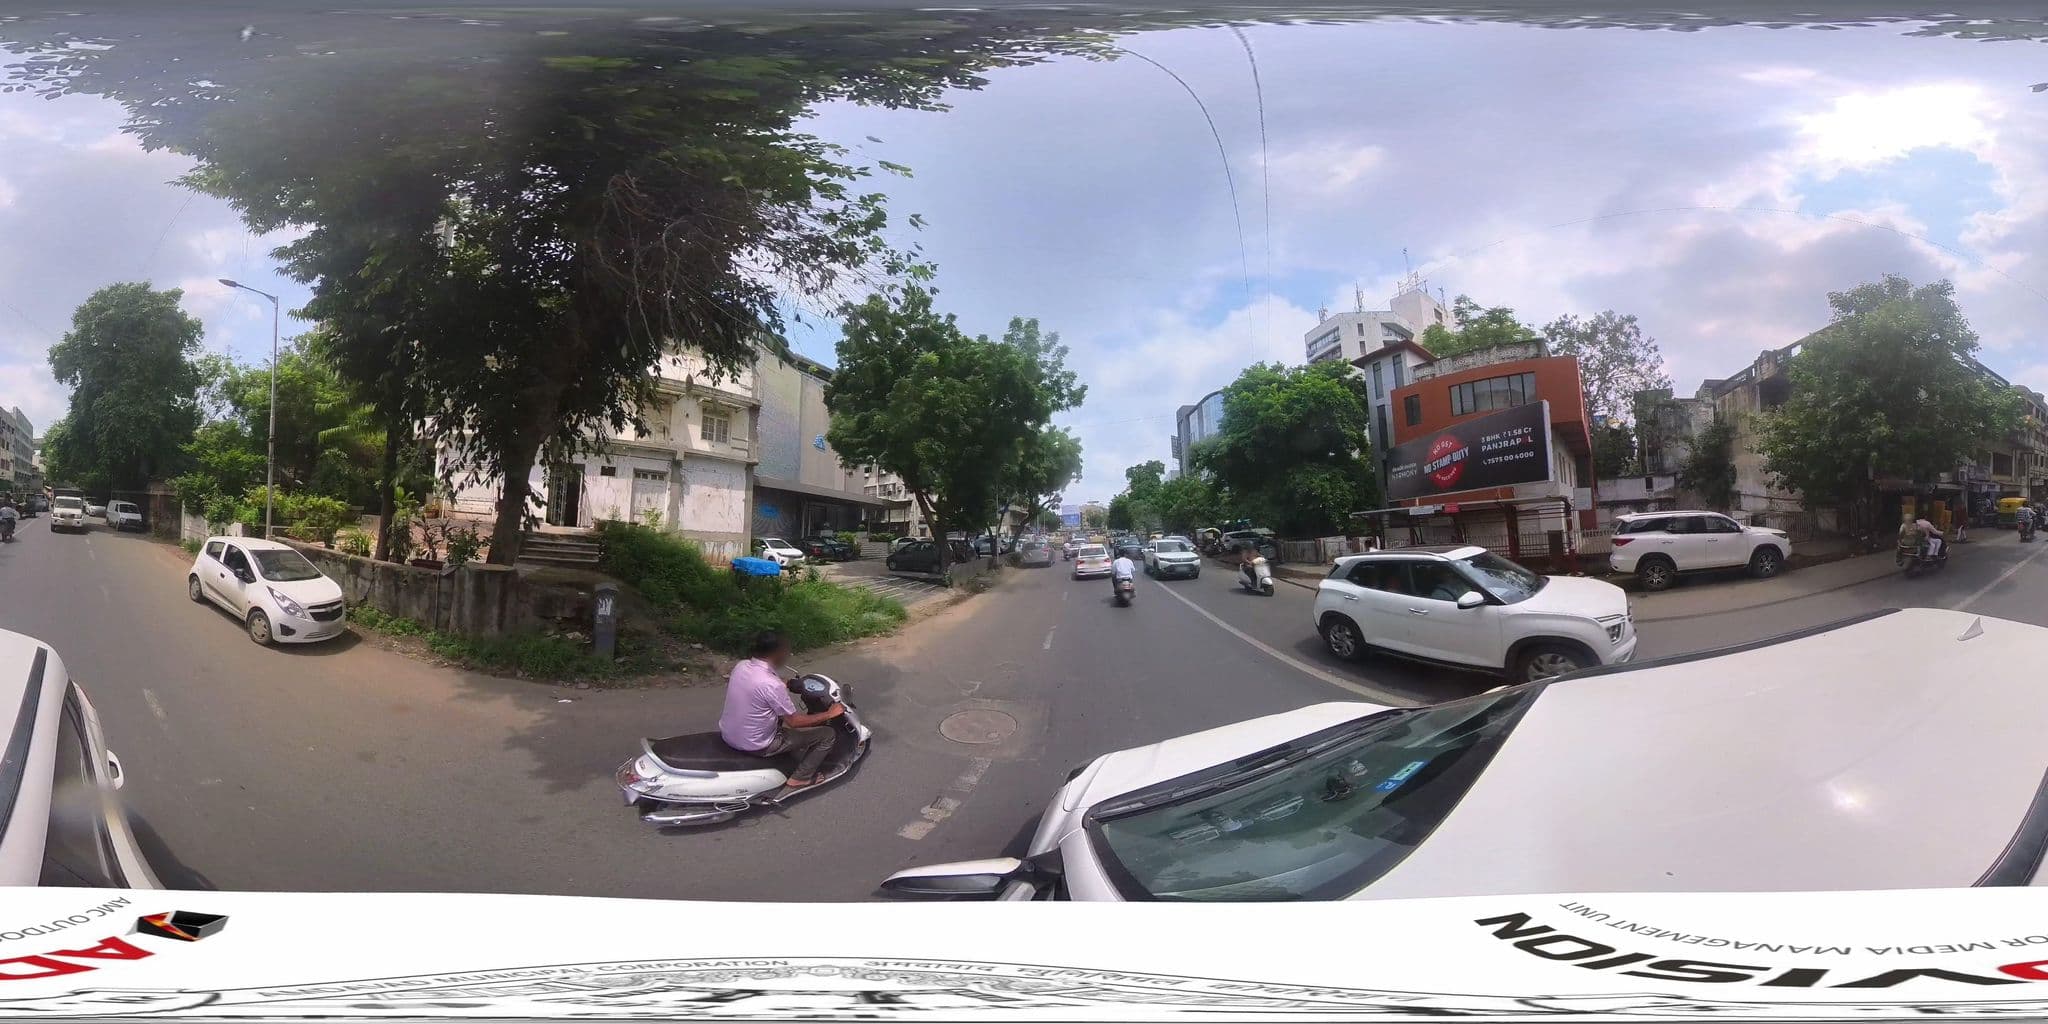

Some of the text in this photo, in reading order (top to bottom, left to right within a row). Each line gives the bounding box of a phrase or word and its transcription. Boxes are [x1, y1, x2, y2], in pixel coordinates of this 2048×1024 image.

[1486, 433, 1500, 442] BHK
[1424, 463, 1432, 474] NO
[1432, 455, 1452, 471] STAMP
[1452, 446, 1470, 462] DUTY
